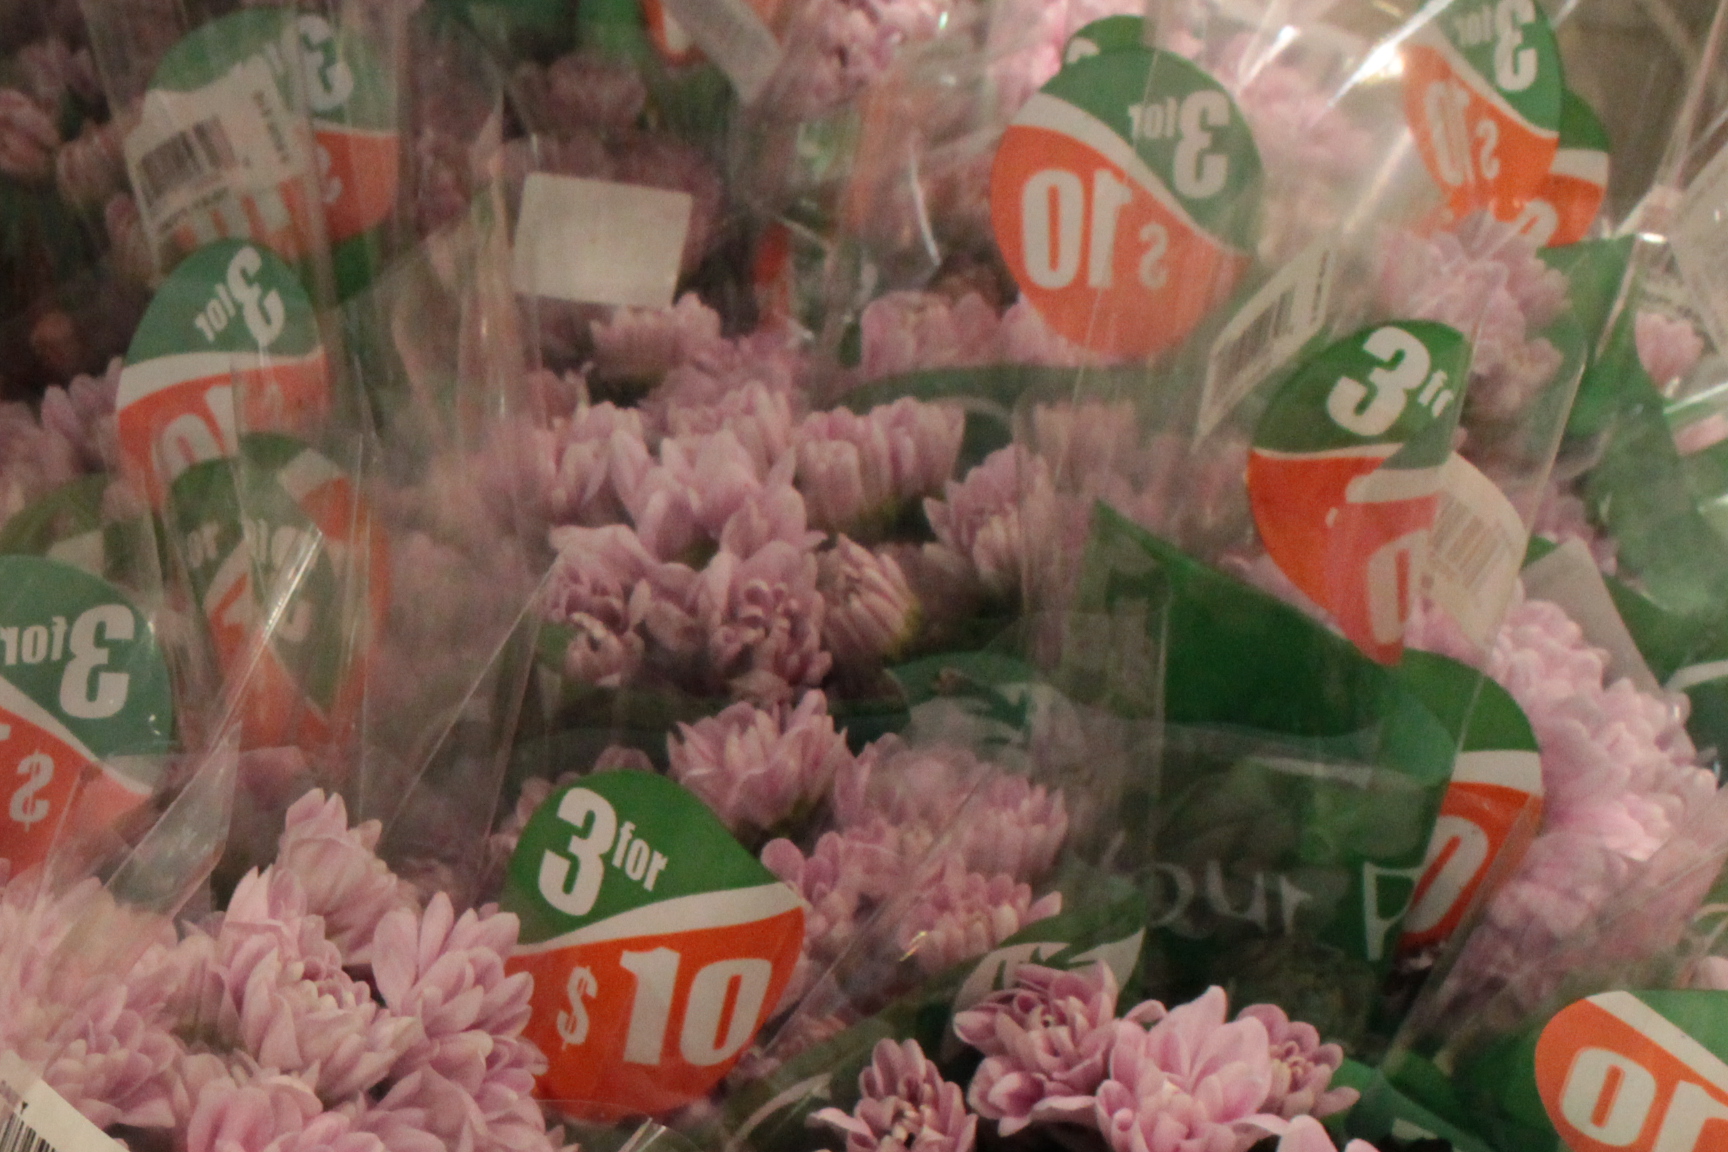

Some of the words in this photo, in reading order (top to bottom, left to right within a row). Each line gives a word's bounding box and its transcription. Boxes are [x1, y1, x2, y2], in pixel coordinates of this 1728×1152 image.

[1327, 327, 1430, 436] 3
[538, 787, 617, 916] 3
[612, 821, 668, 891] for
